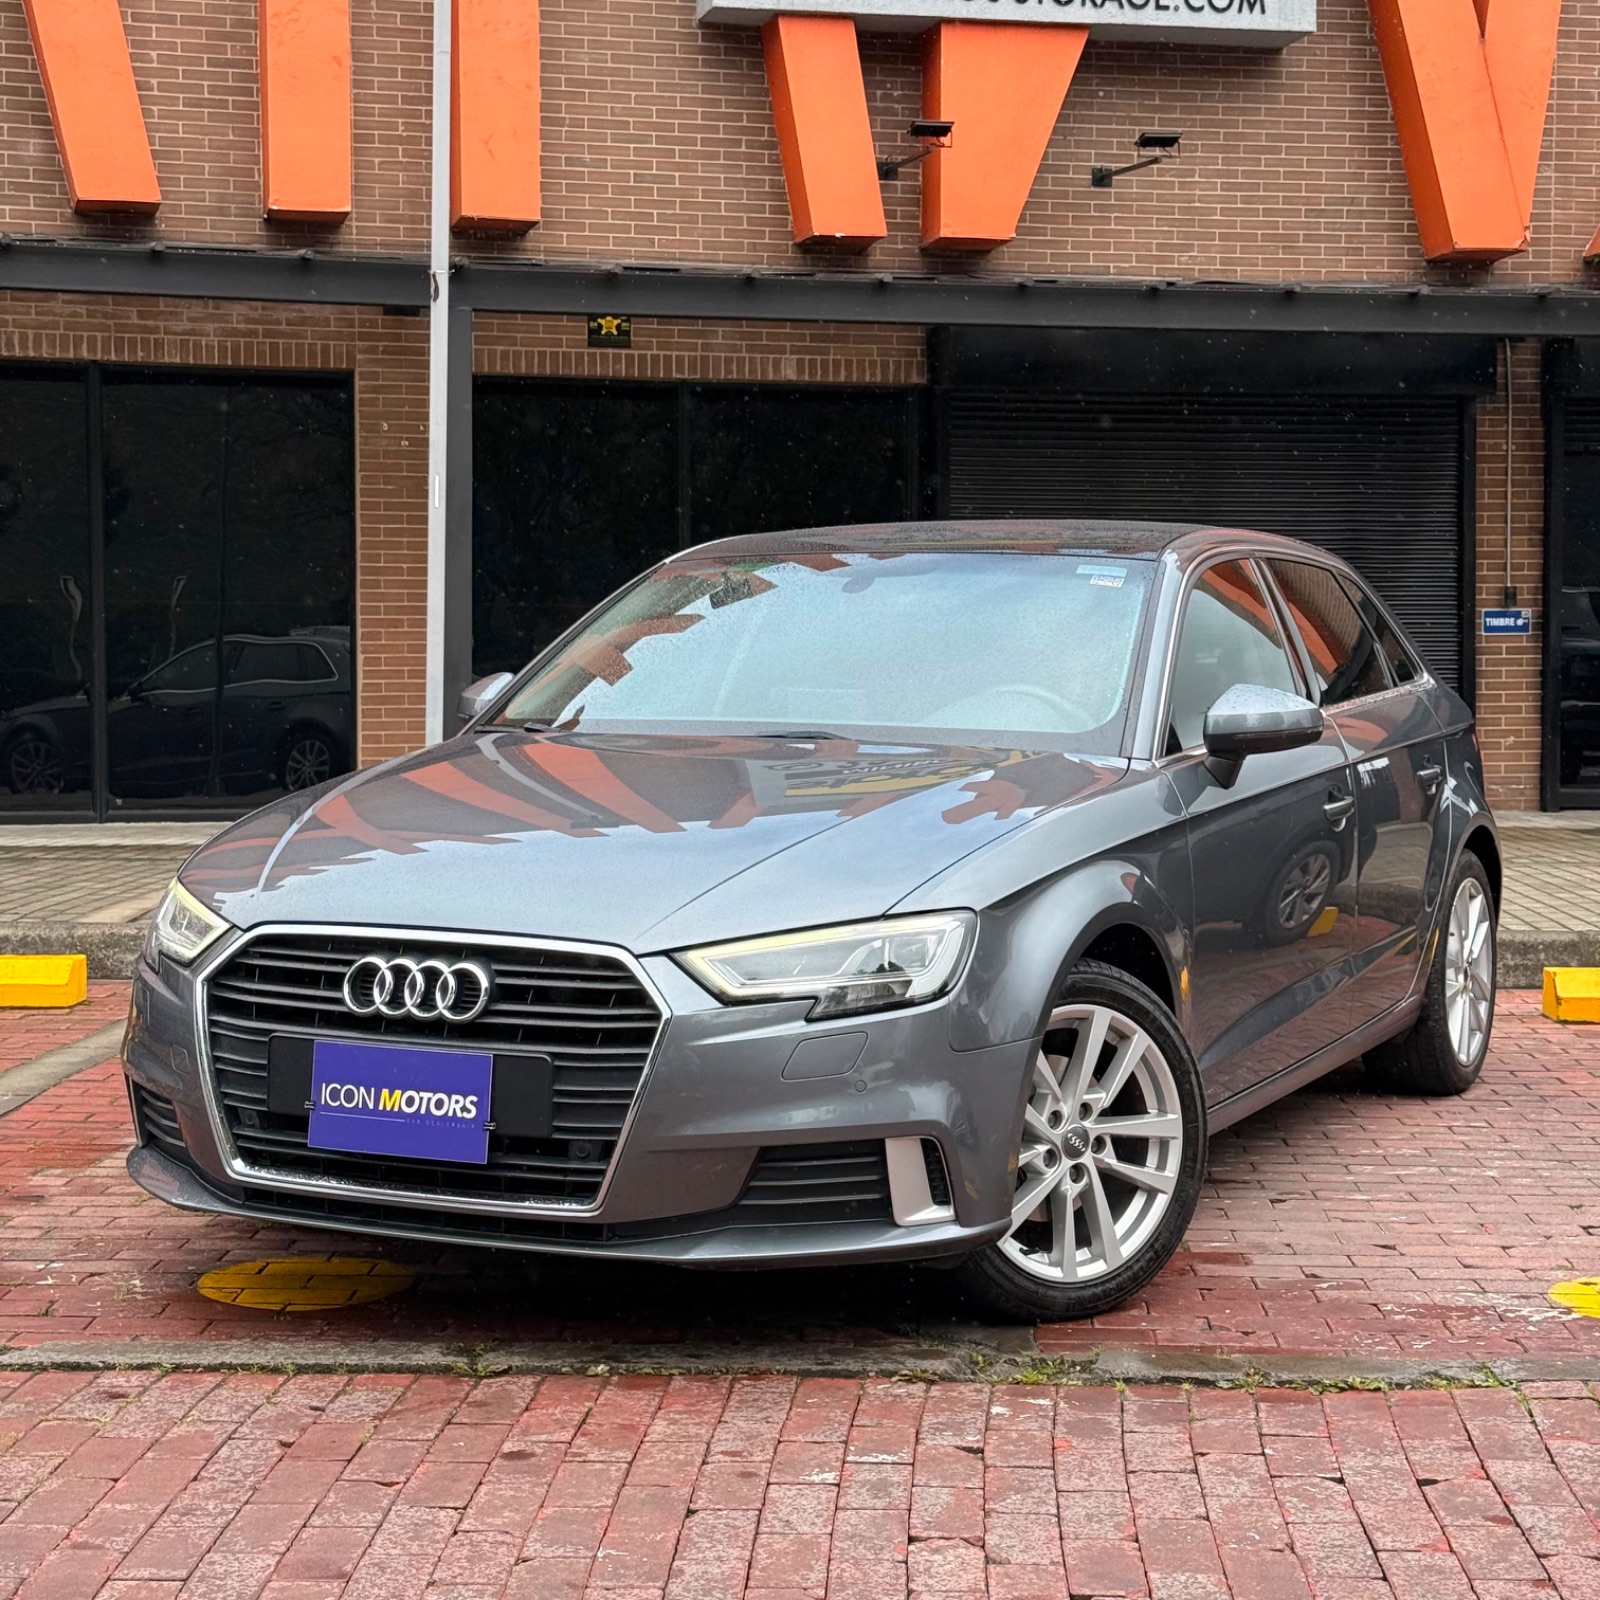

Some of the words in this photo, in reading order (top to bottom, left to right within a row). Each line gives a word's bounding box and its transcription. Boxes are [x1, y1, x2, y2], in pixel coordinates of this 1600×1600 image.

[1485, 617, 1515, 627] TIMBRE
[321, 1082, 375, 1110] ICON
[378, 1088, 478, 1119] MOTORS
